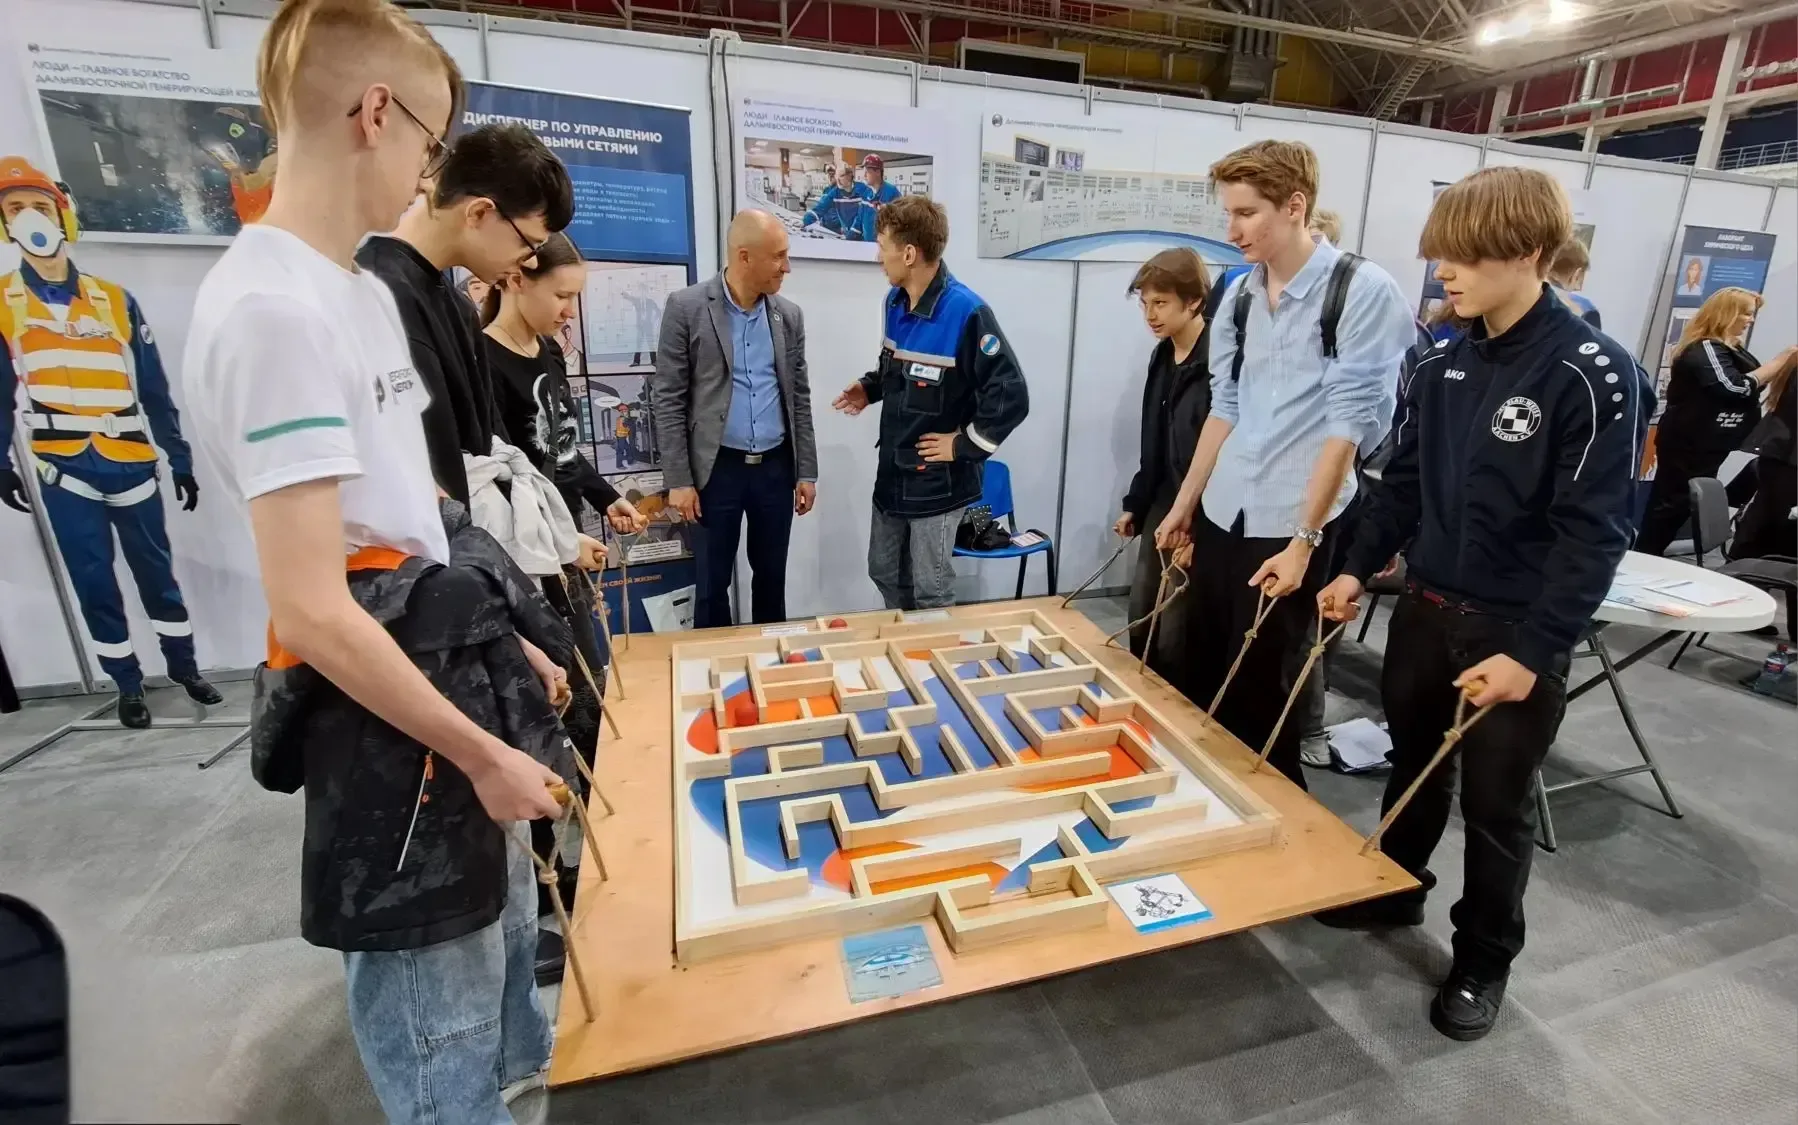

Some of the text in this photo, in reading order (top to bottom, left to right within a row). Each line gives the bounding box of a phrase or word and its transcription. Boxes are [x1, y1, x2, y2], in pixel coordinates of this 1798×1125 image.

[551, 120, 571, 133] ПО
[573, 123, 663, 143] УПРАВЛЕНИЮ
[538, 135, 639, 155] ВЫМИ СЕТЯМИ
